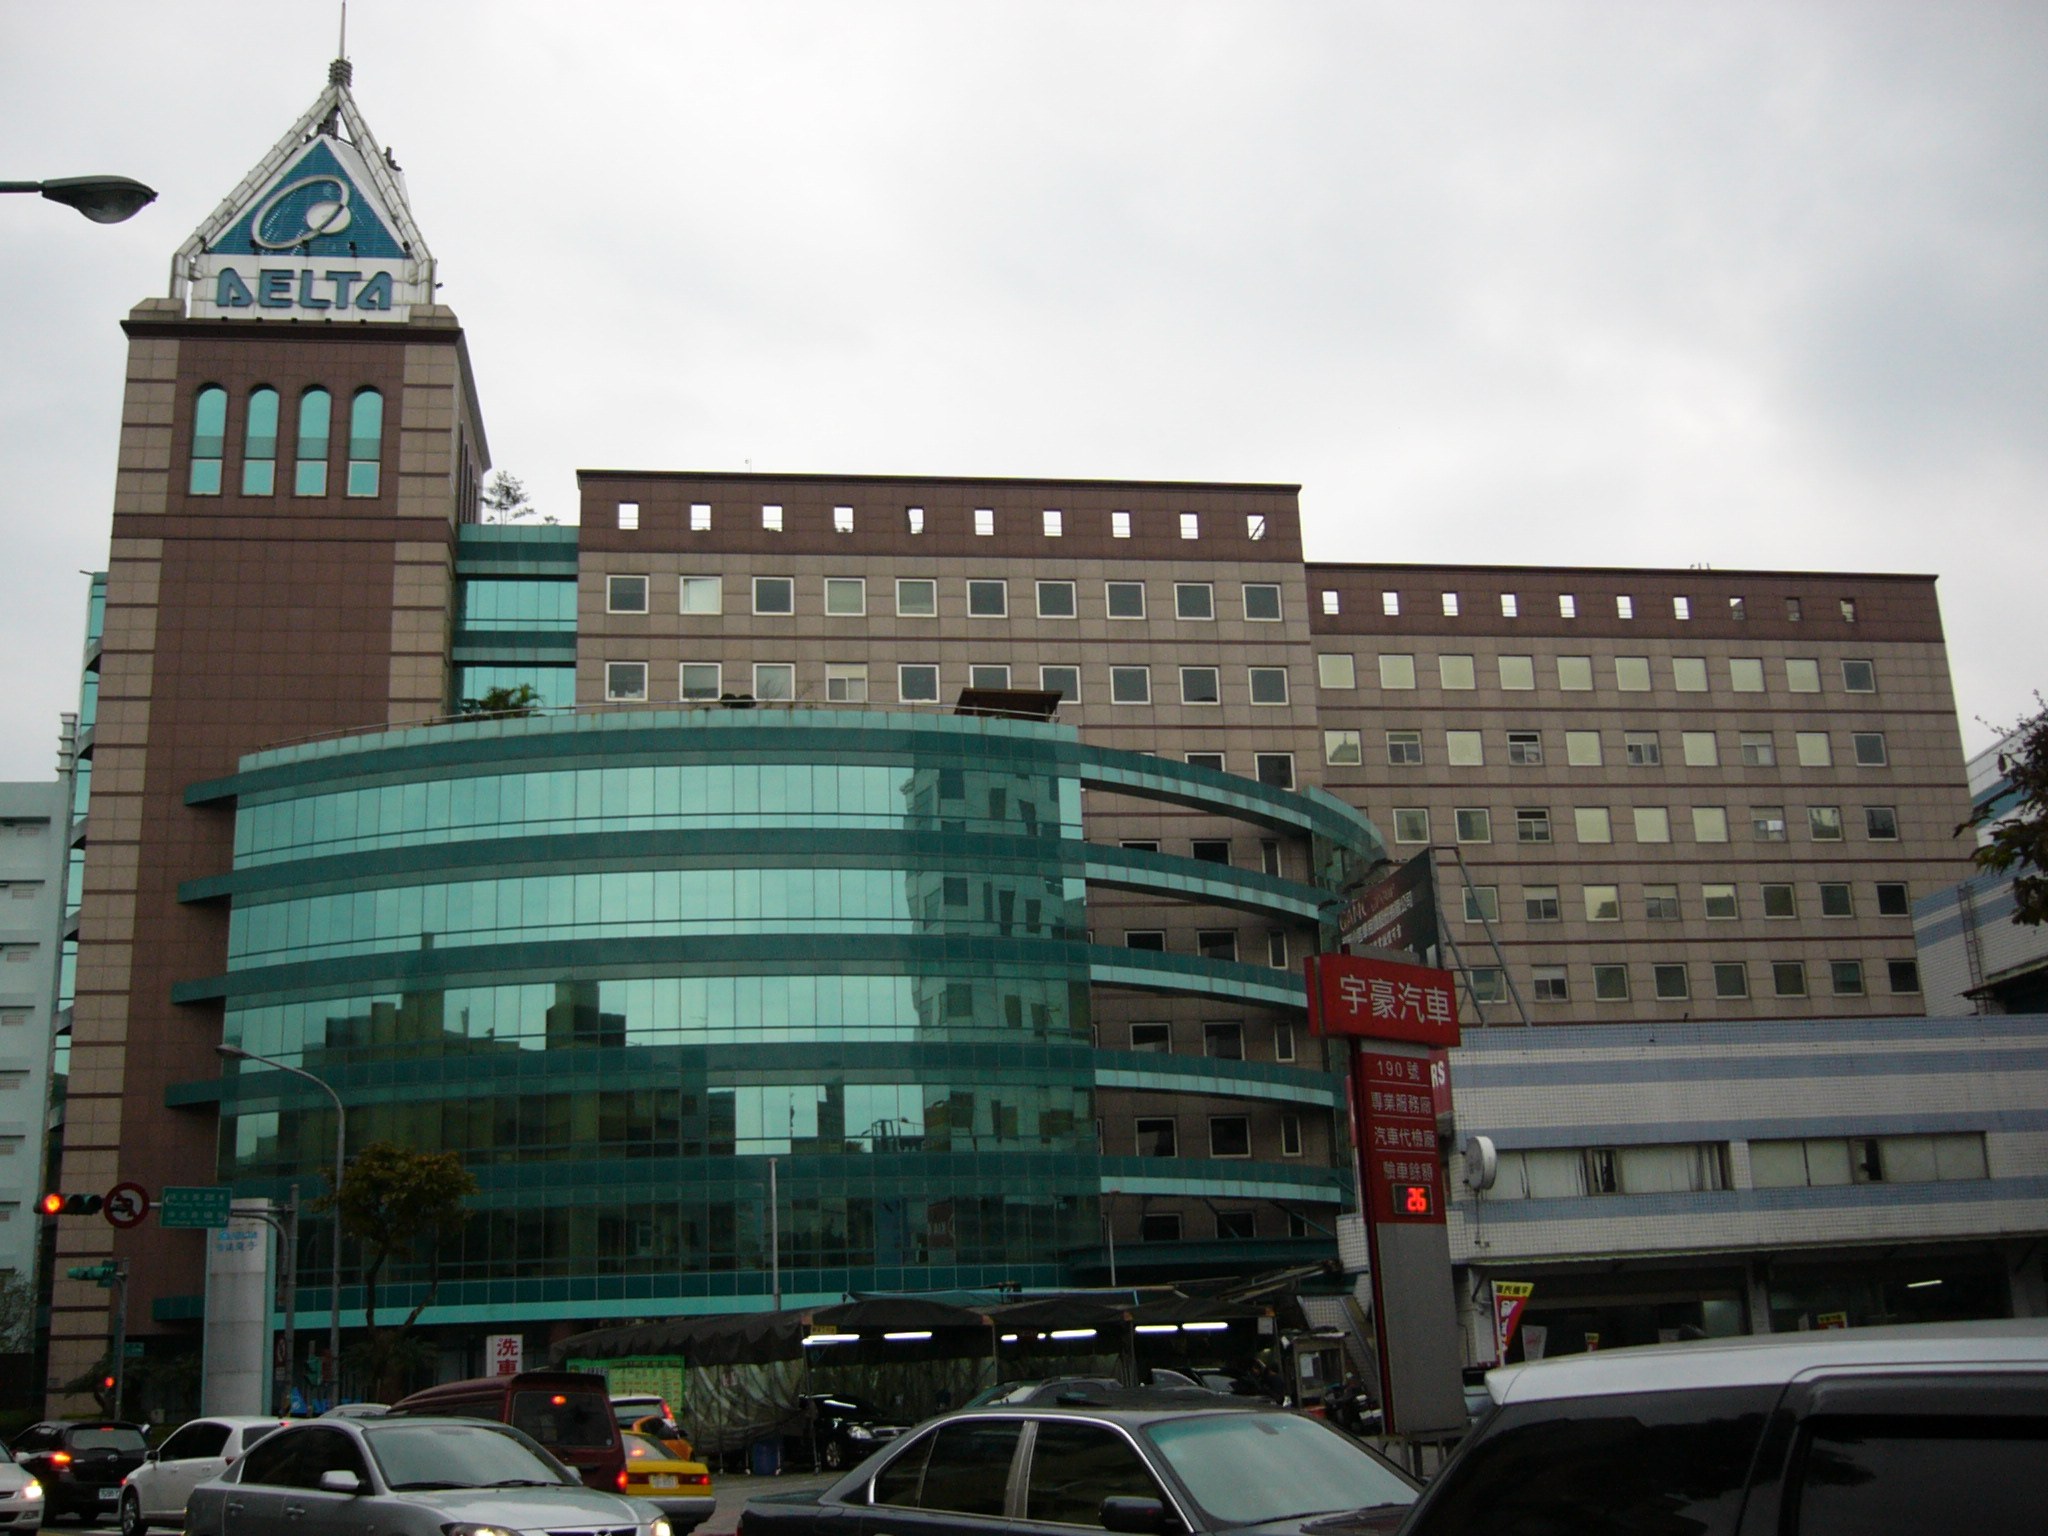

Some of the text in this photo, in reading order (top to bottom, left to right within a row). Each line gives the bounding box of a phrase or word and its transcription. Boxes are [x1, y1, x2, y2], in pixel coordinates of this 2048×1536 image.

[216, 266, 393, 311] DELTA
[1339, 973, 1452, 1027] 宇豪汽車
[1376, 1060, 1420, 1081] 190 號
[1370, 1091, 1432, 1115] 專業服務廠
[1373, 1125, 1436, 1149] 汽車代檢廠
[1382, 1160, 1434, 1182] 驗車餘額
[1406, 1186, 1427, 1213] 26
